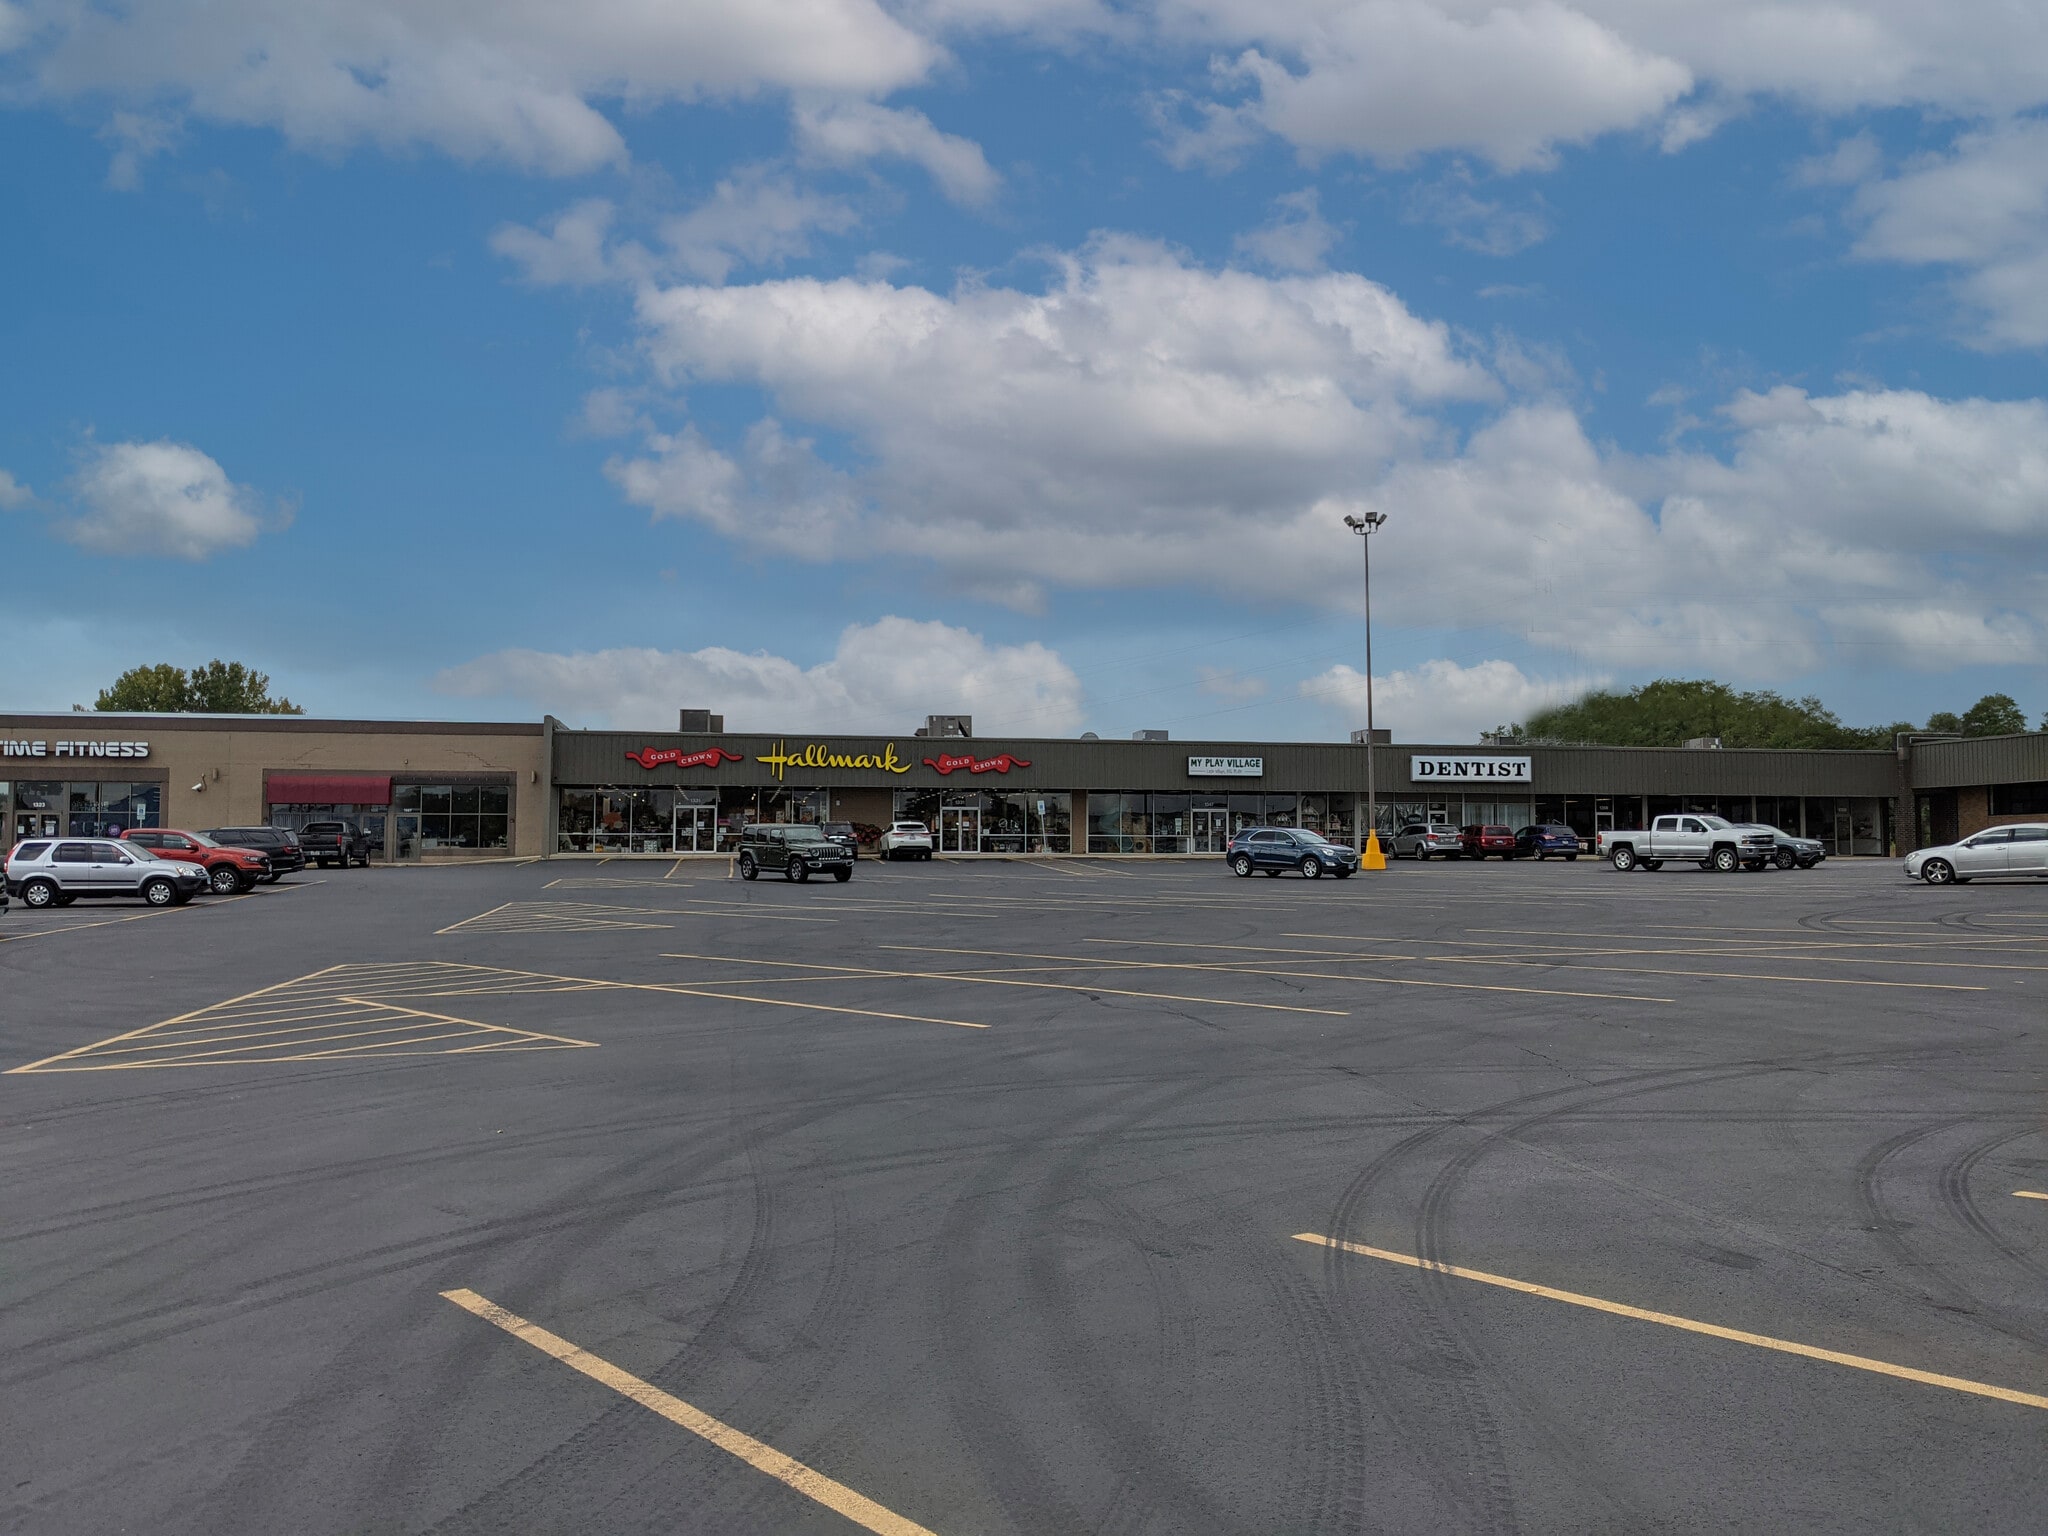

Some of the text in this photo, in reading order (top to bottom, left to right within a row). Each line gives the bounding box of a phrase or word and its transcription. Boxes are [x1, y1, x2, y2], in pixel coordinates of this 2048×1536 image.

[0, 740, 149, 757] IME FITNESS
[681, 754, 712, 764] CROWN
[756, 739, 912, 781] Hallmark
[946, 758, 1003, 770] GOLD CROWN
[1191, 759, 1261, 768] MY PLAY VILLAGE
[1418, 761, 1526, 777] DENTIST
